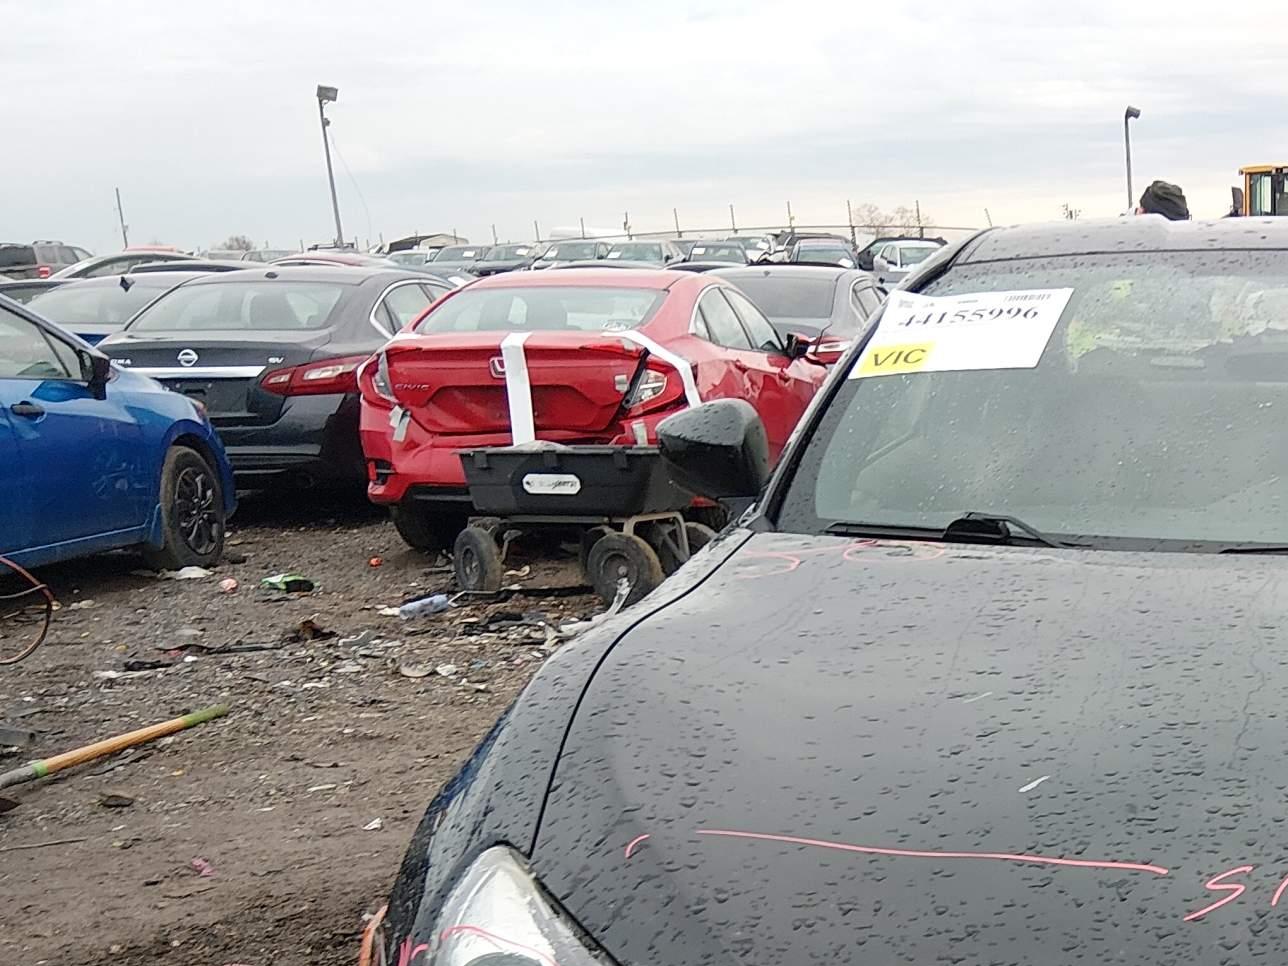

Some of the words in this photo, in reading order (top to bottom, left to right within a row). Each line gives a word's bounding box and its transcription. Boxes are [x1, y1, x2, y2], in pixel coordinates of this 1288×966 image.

[898, 305, 1040, 328] 44155996
[873, 347, 927, 368] VIC
[394, 382, 431, 392] CIVIC
